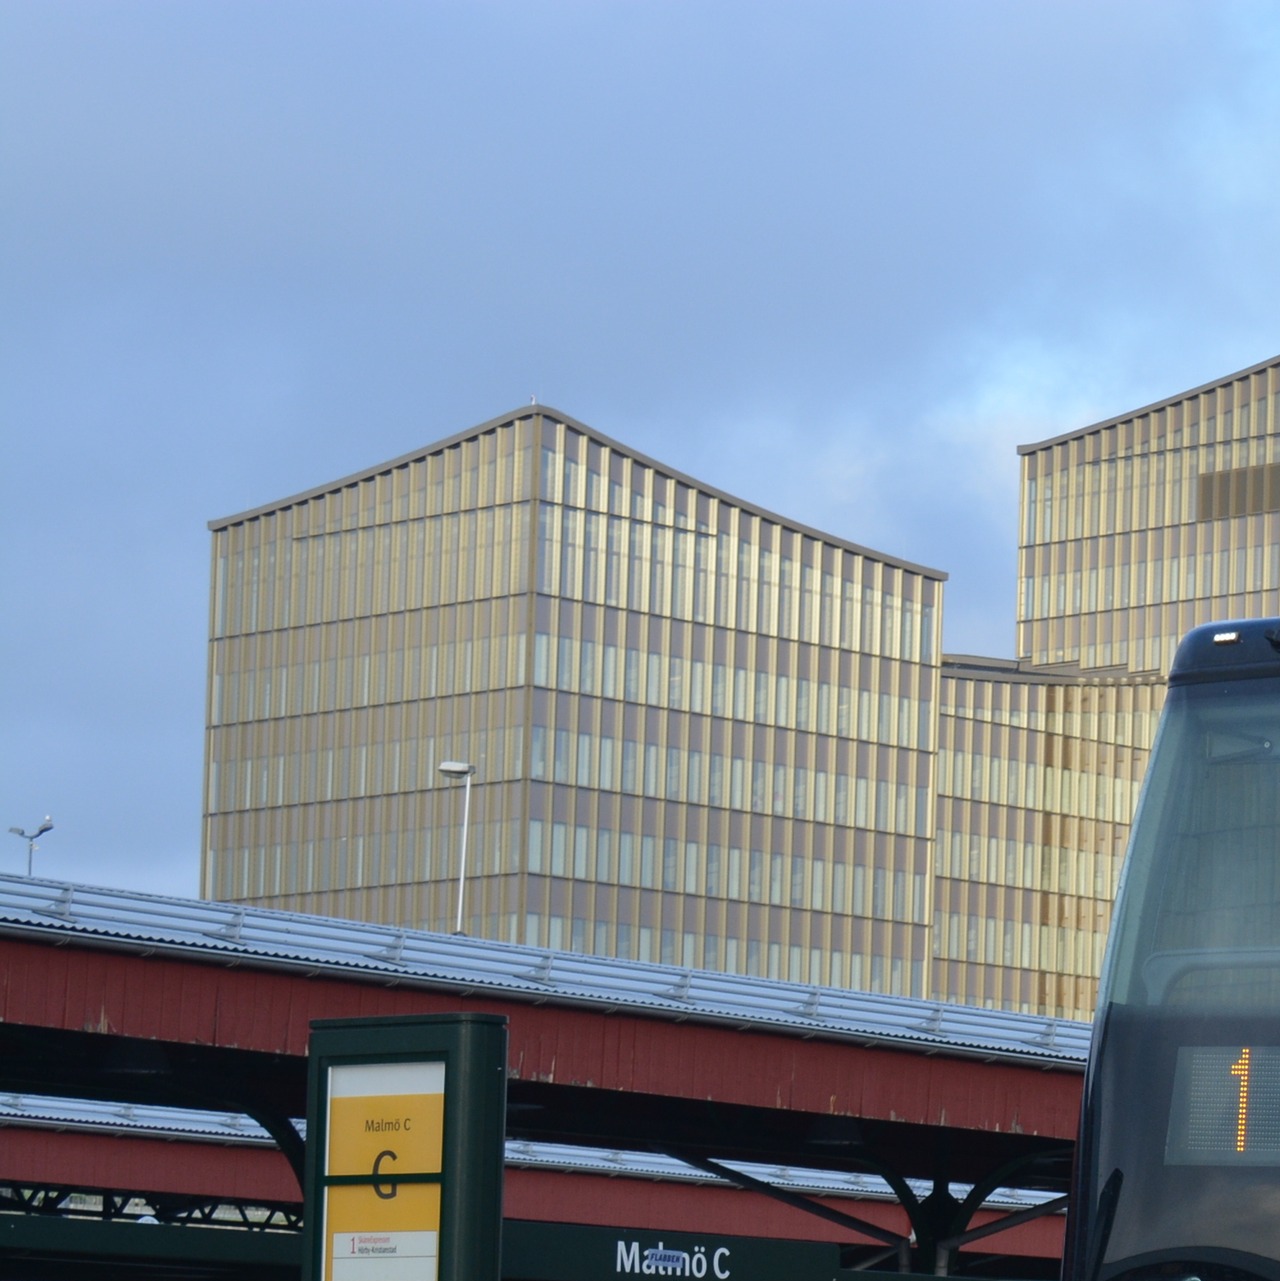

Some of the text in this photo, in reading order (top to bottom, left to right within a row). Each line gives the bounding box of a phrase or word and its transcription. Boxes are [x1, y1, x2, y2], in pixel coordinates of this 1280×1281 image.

[1231, 1048, 1250, 1152] 1
[365, 1118, 411, 1132] Malmö C
[350, 1236, 356, 1254] 1
[713, 1247, 731, 1279] C
